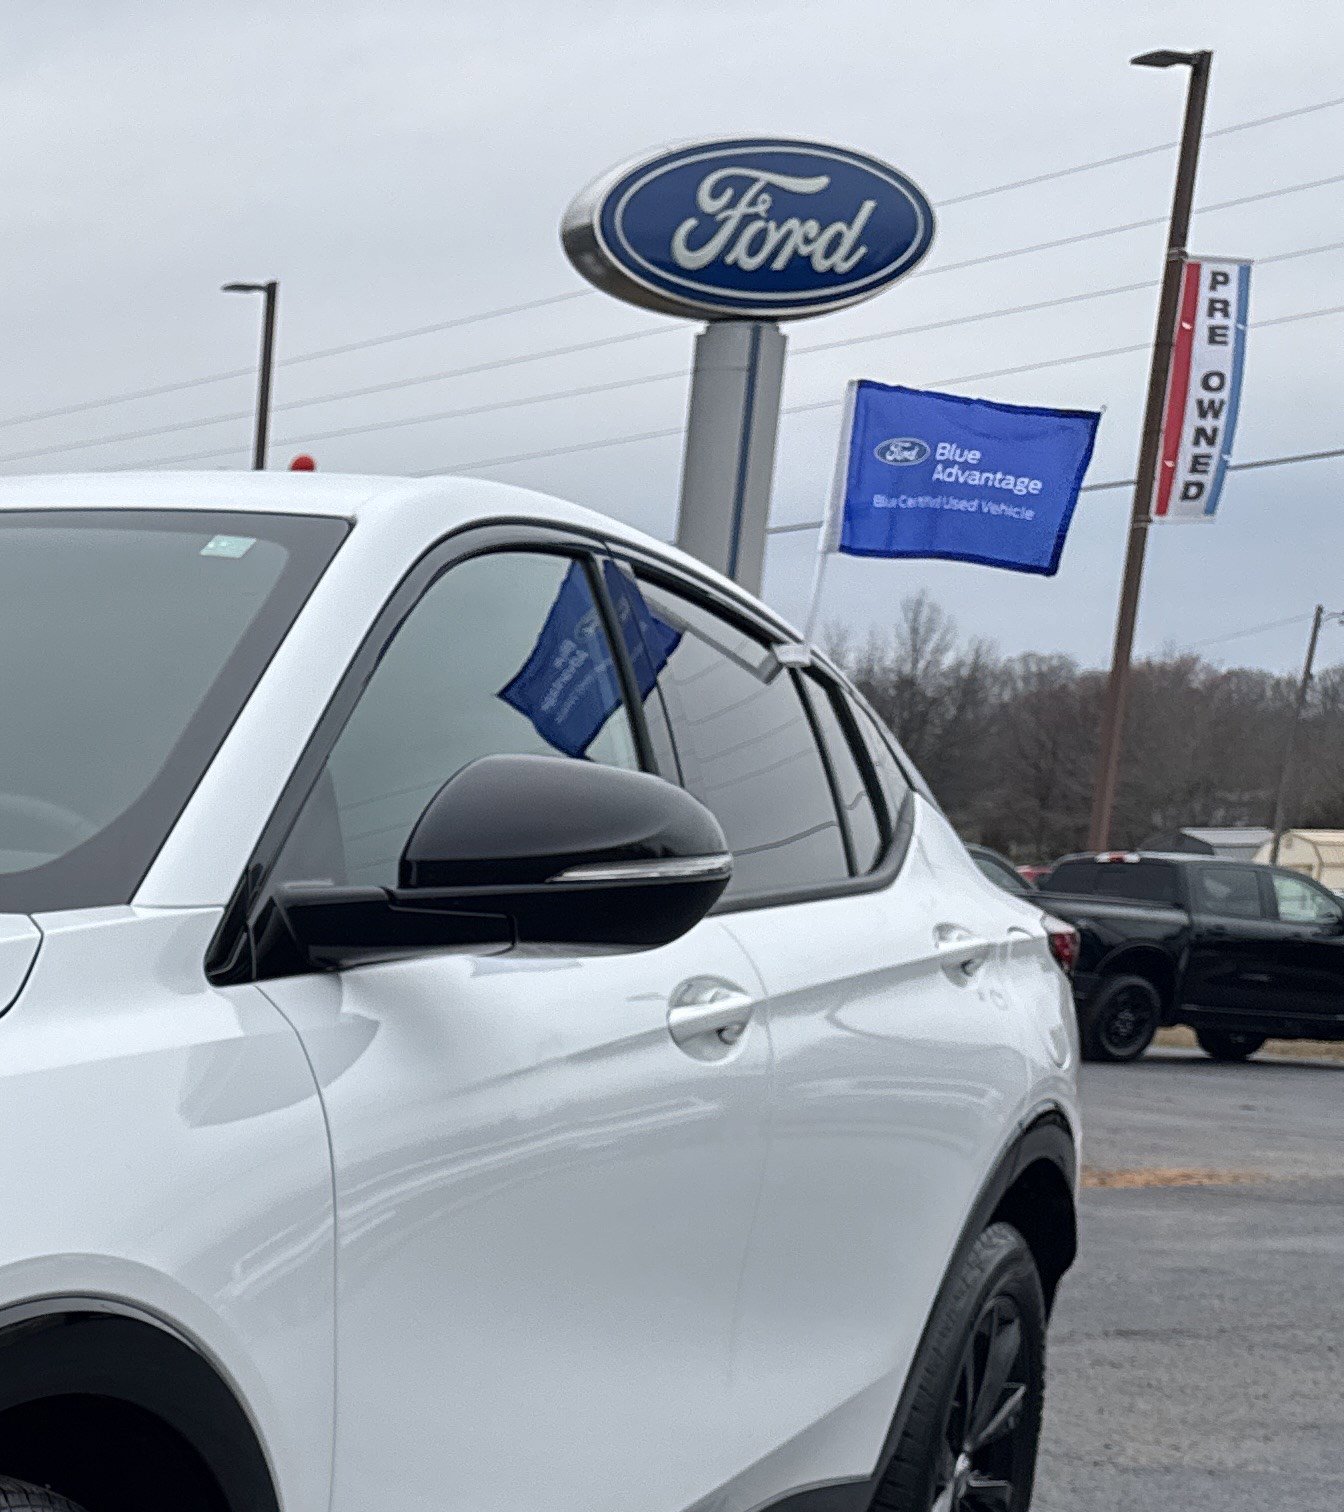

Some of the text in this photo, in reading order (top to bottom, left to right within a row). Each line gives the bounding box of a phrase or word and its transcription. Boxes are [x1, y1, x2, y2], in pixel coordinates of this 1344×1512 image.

[671, 166, 878, 274] Ford
[1179, 270, 1231, 502] PRE OWNED
[931, 463, 1043, 496] Advantage
[934, 441, 982, 464] Blue
